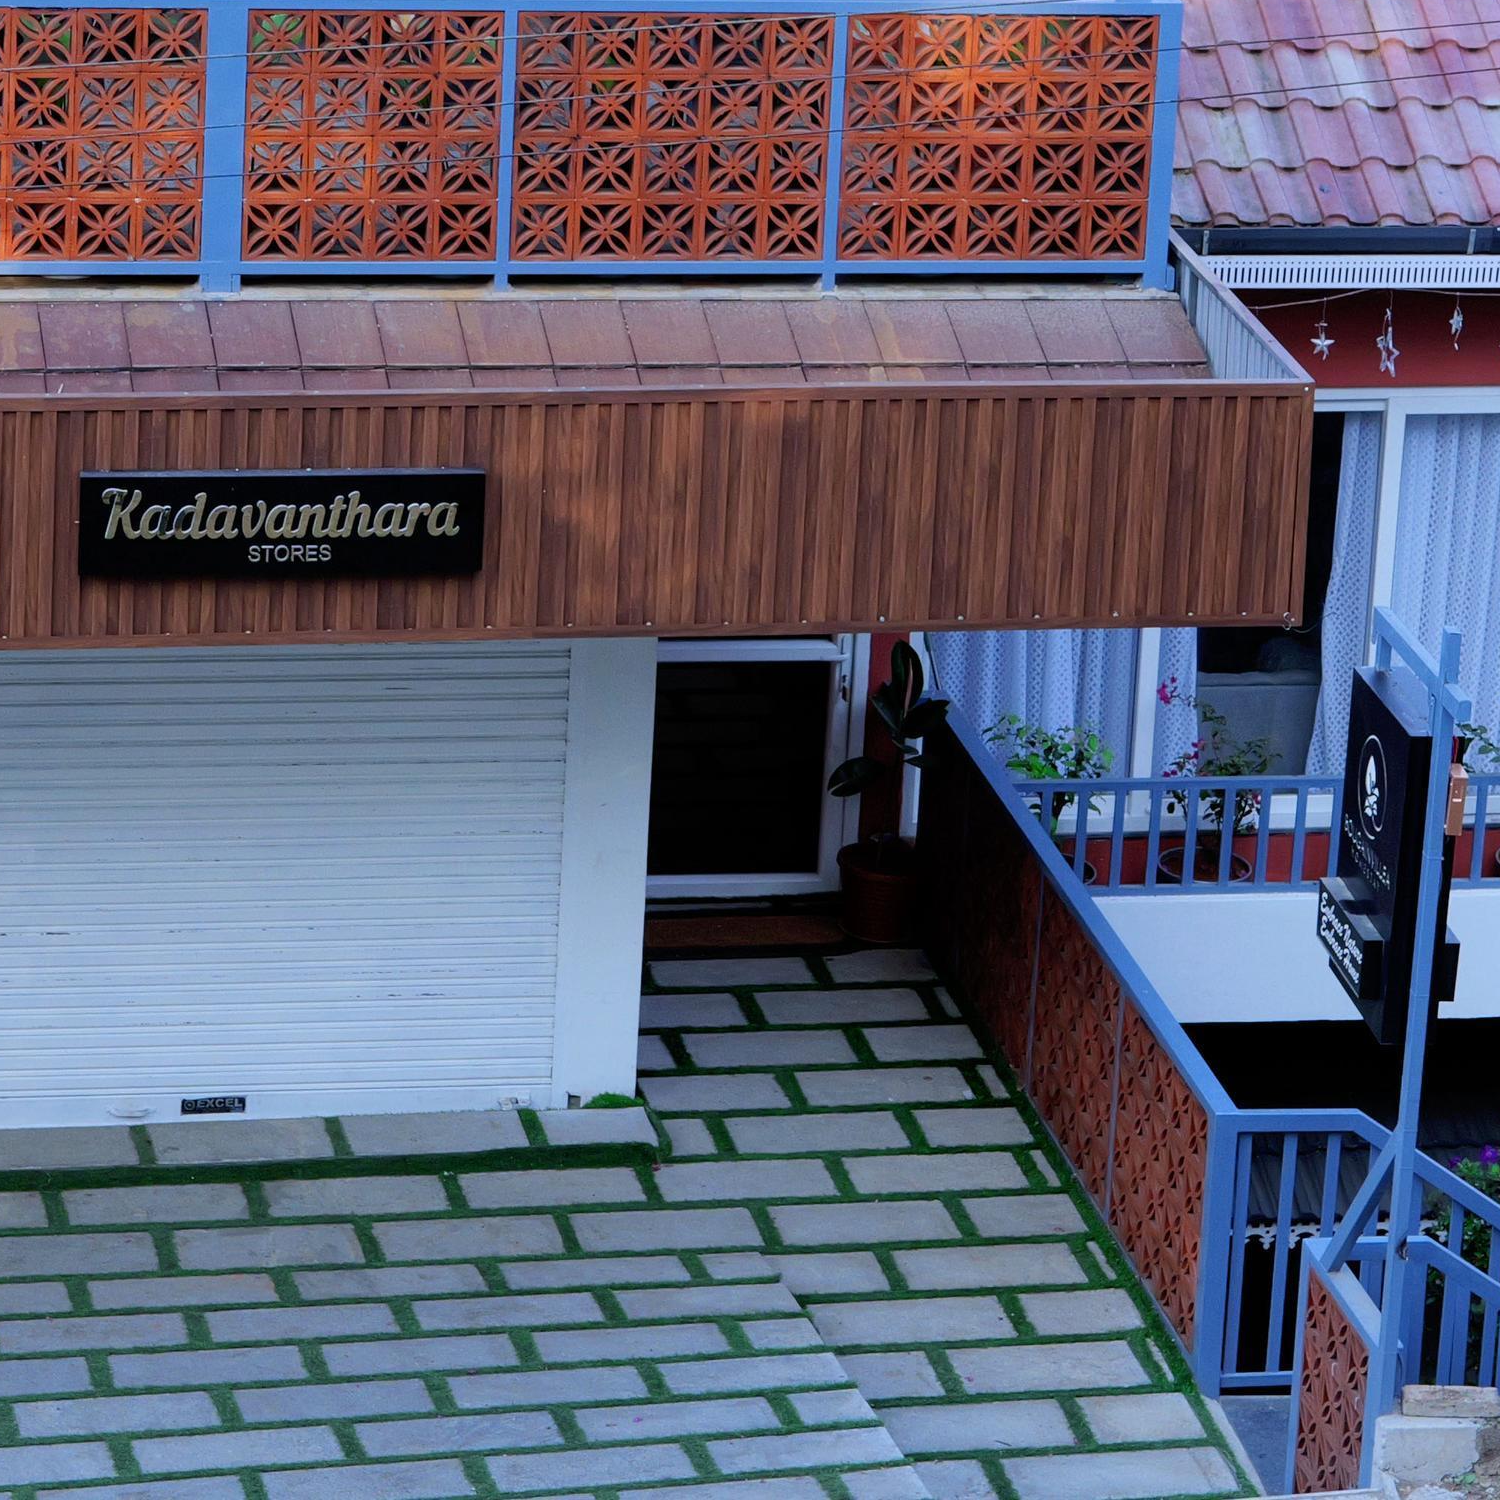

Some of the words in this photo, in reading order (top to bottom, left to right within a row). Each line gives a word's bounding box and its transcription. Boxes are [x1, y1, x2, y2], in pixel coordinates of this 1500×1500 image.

[101, 487, 460, 539] Kadavanthara
[248, 544, 332, 562] STORES
[196, 1098, 243, 1108] EXCEL
